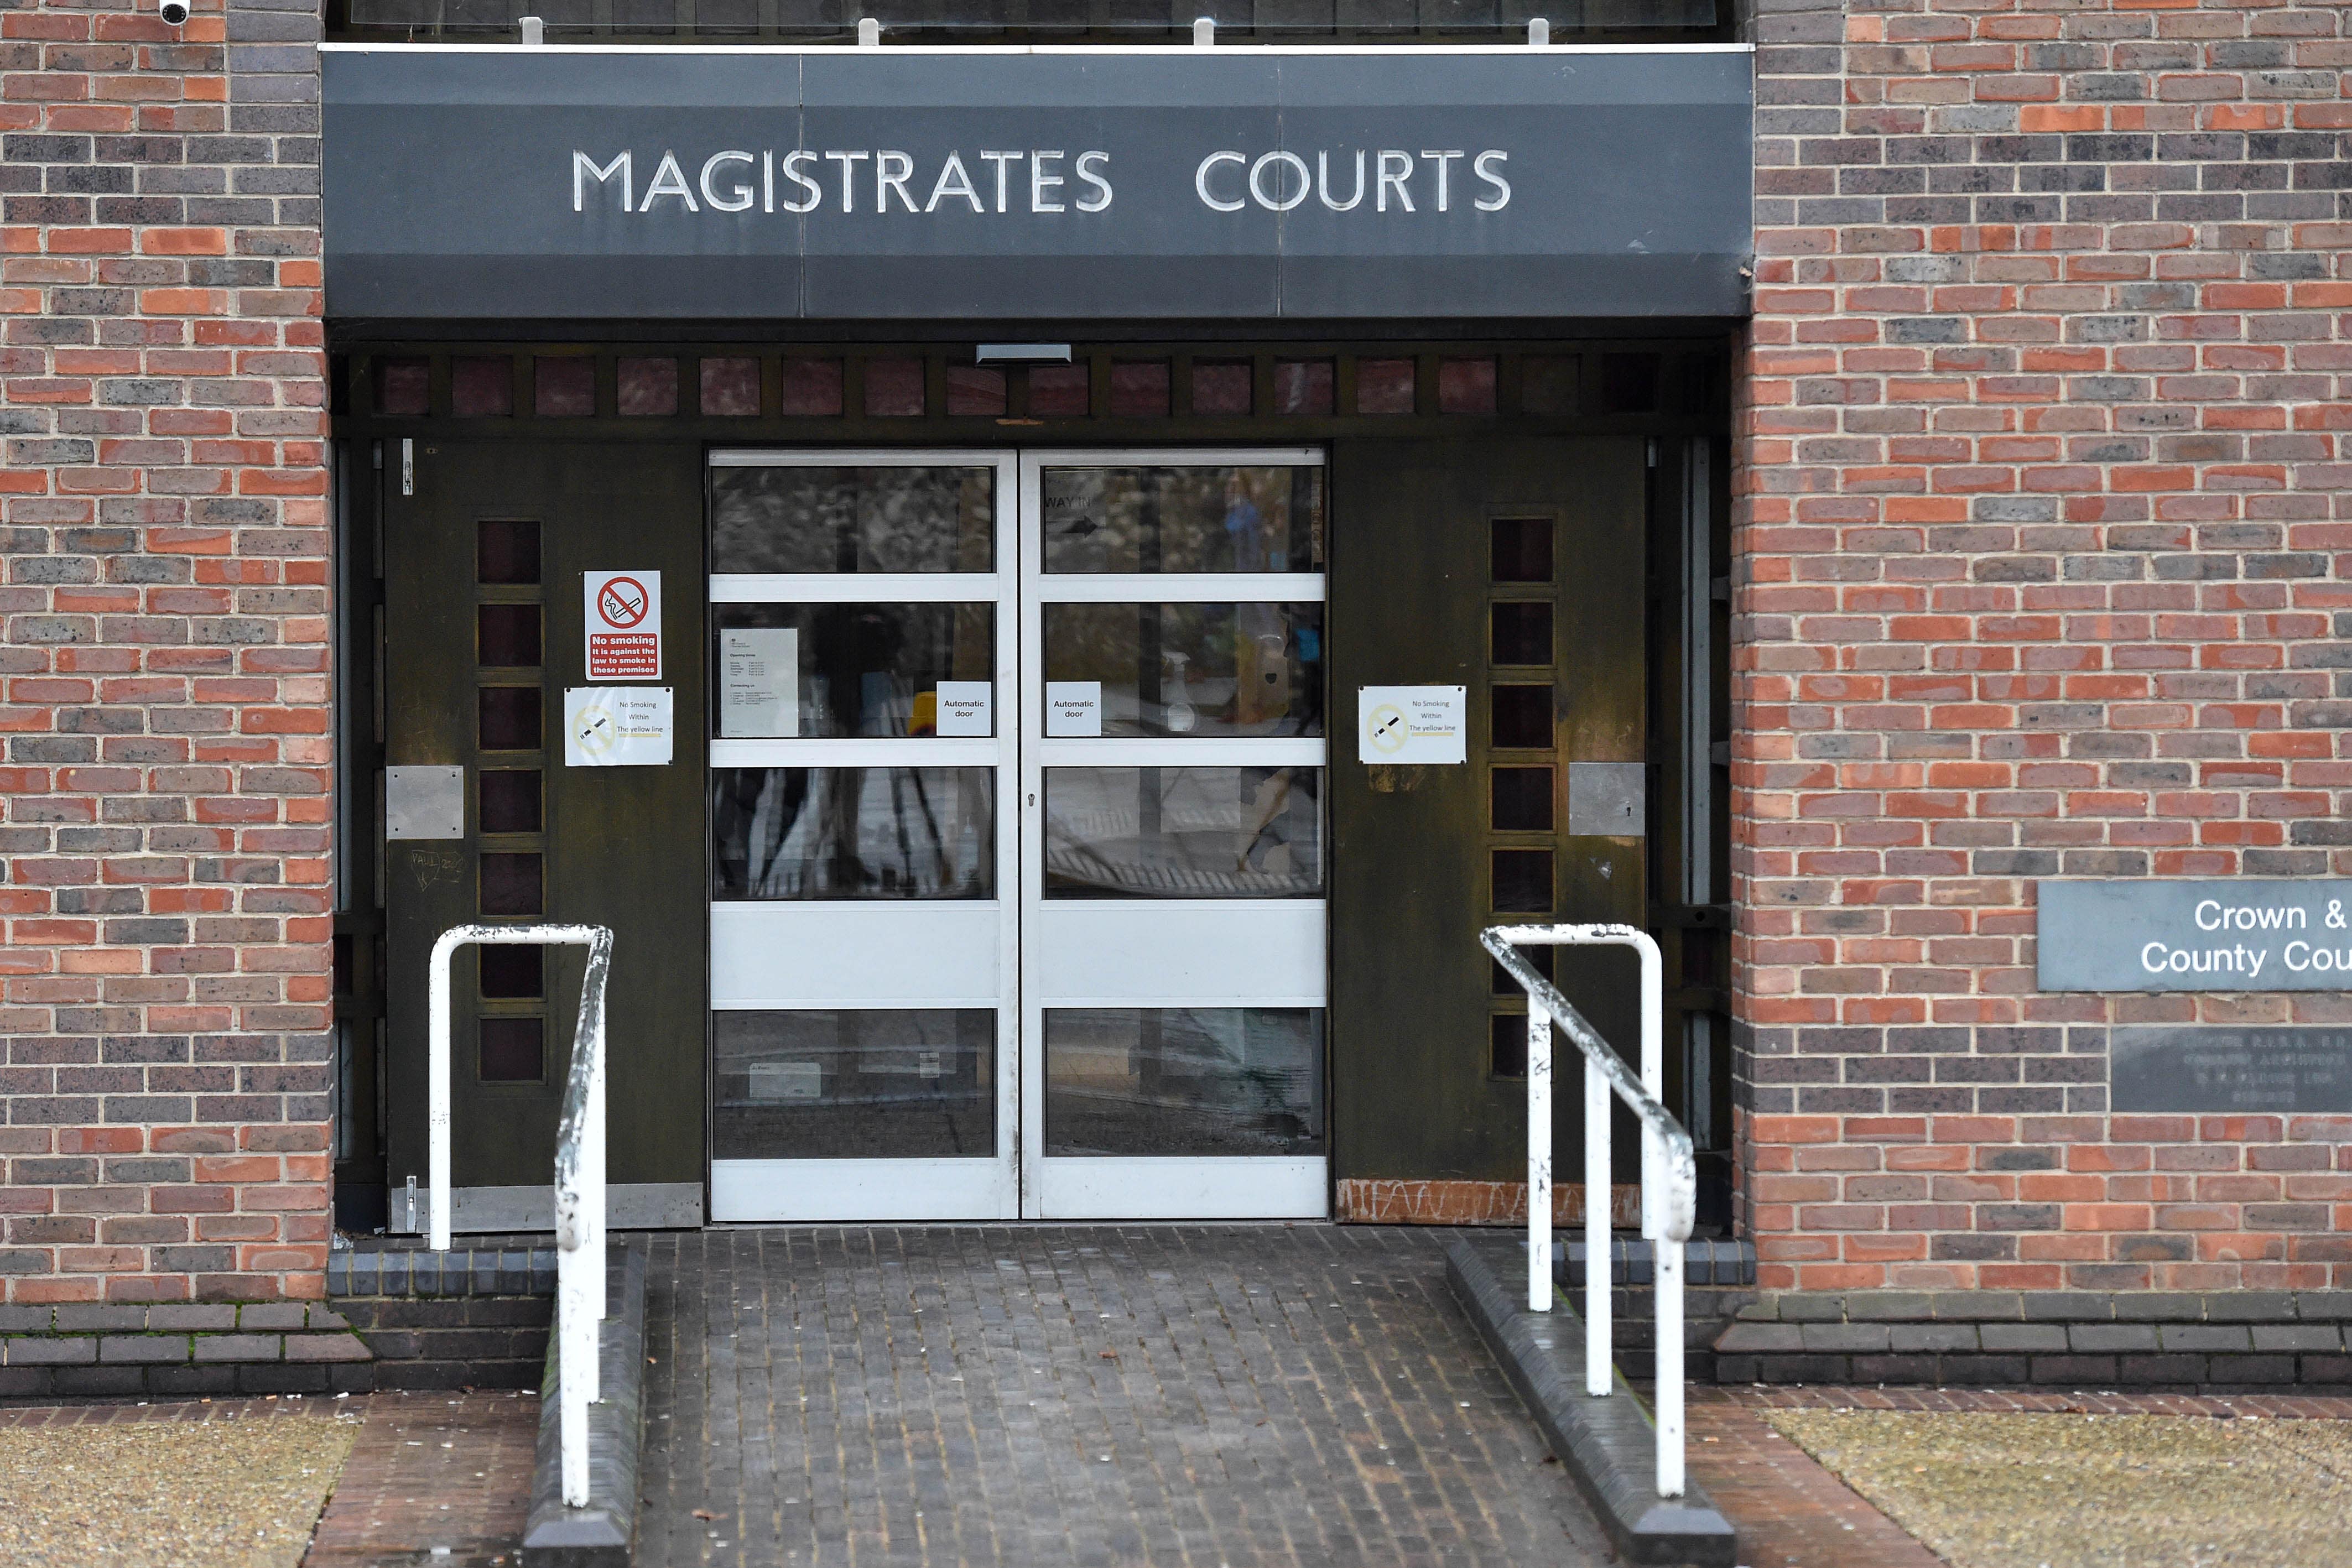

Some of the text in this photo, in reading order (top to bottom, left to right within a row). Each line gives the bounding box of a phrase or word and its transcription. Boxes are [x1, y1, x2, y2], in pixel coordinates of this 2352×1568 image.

[573, 149, 1512, 213] MAGISTRATES COURTS
[592, 635, 655, 646] No smoking
[610, 648, 640, 656] against
[618, 666, 655, 674] premises
[1053, 700, 1094, 708] Automatic
[1064, 710, 1084, 718] door
[630, 726, 651, 734] yellow
[2194, 899, 2348, 930] Crown &
[2141, 941, 2267, 978] County
